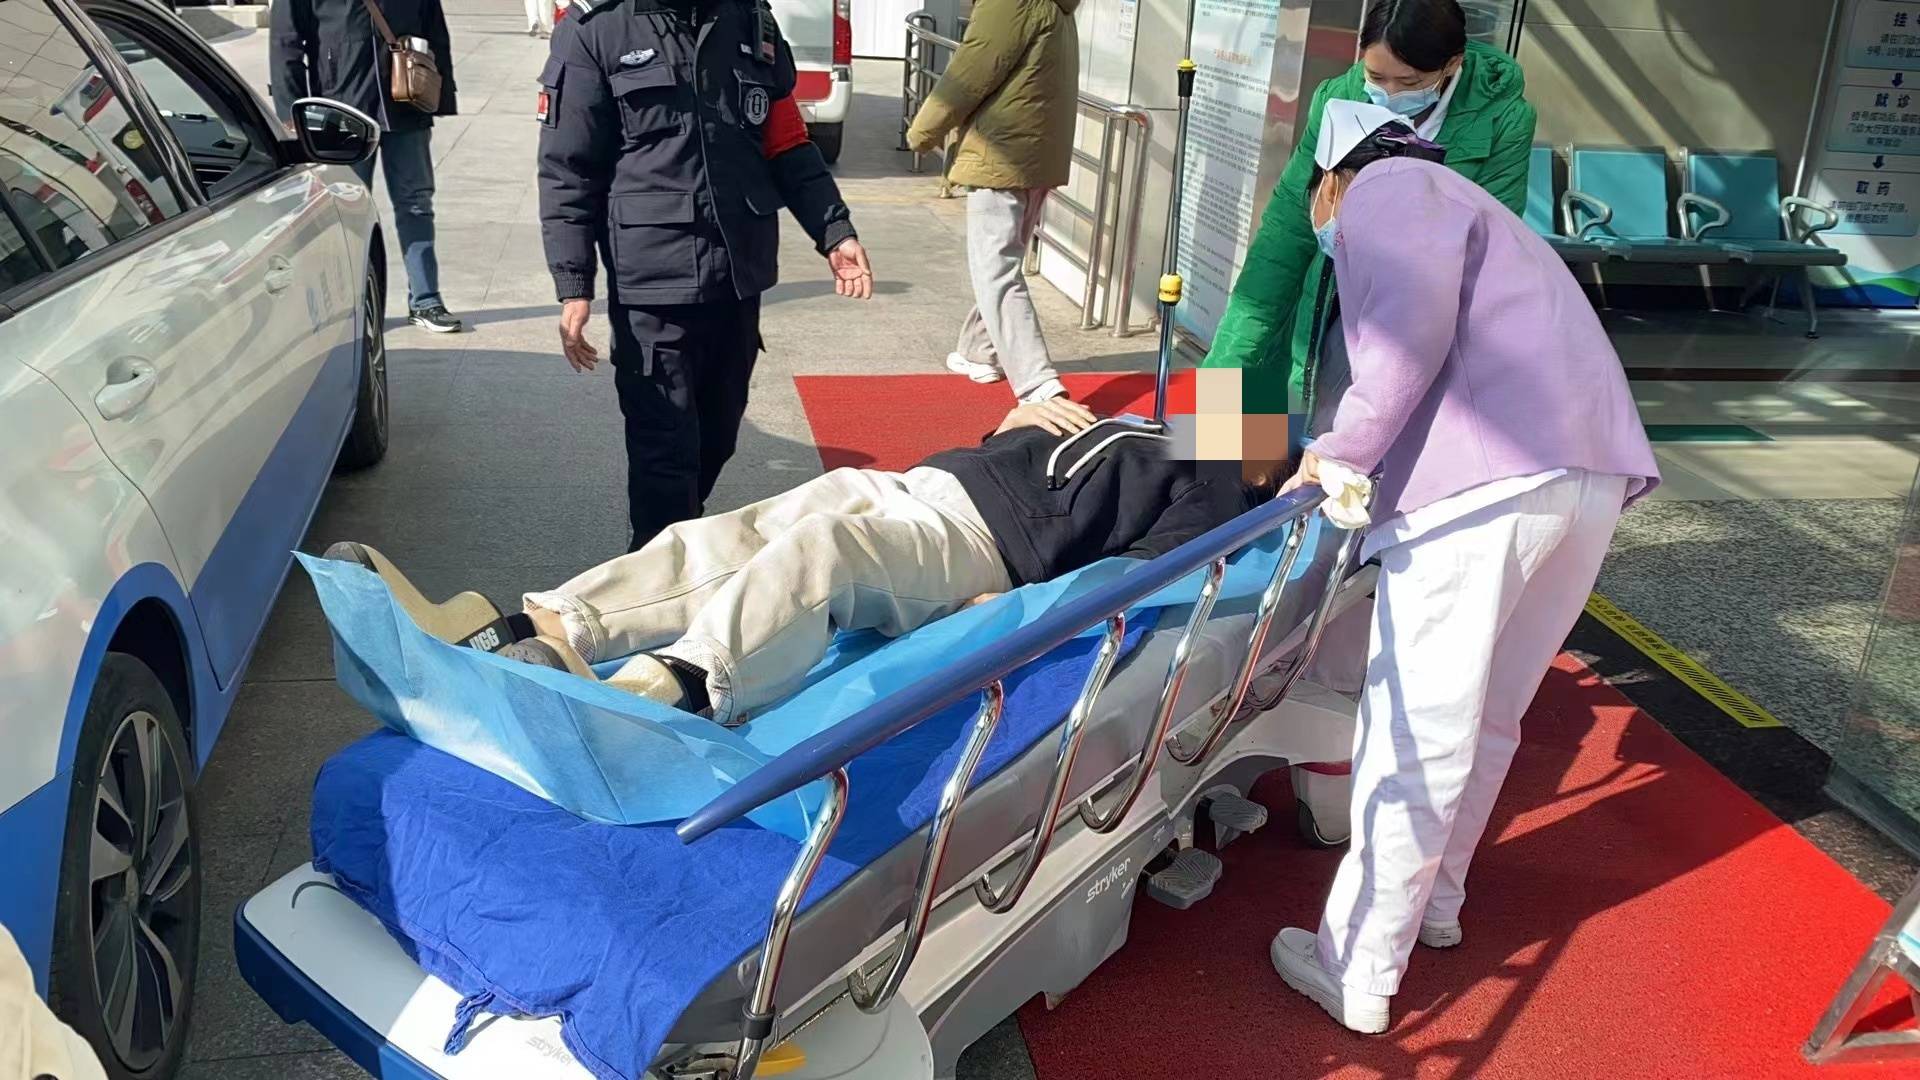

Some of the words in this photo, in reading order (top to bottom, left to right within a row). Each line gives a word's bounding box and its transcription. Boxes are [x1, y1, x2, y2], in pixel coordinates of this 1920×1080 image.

[1874, 92, 1911, 108] 就诊
[1856, 180, 1891, 196] 取药
[1086, 857, 1131, 903] stryker
